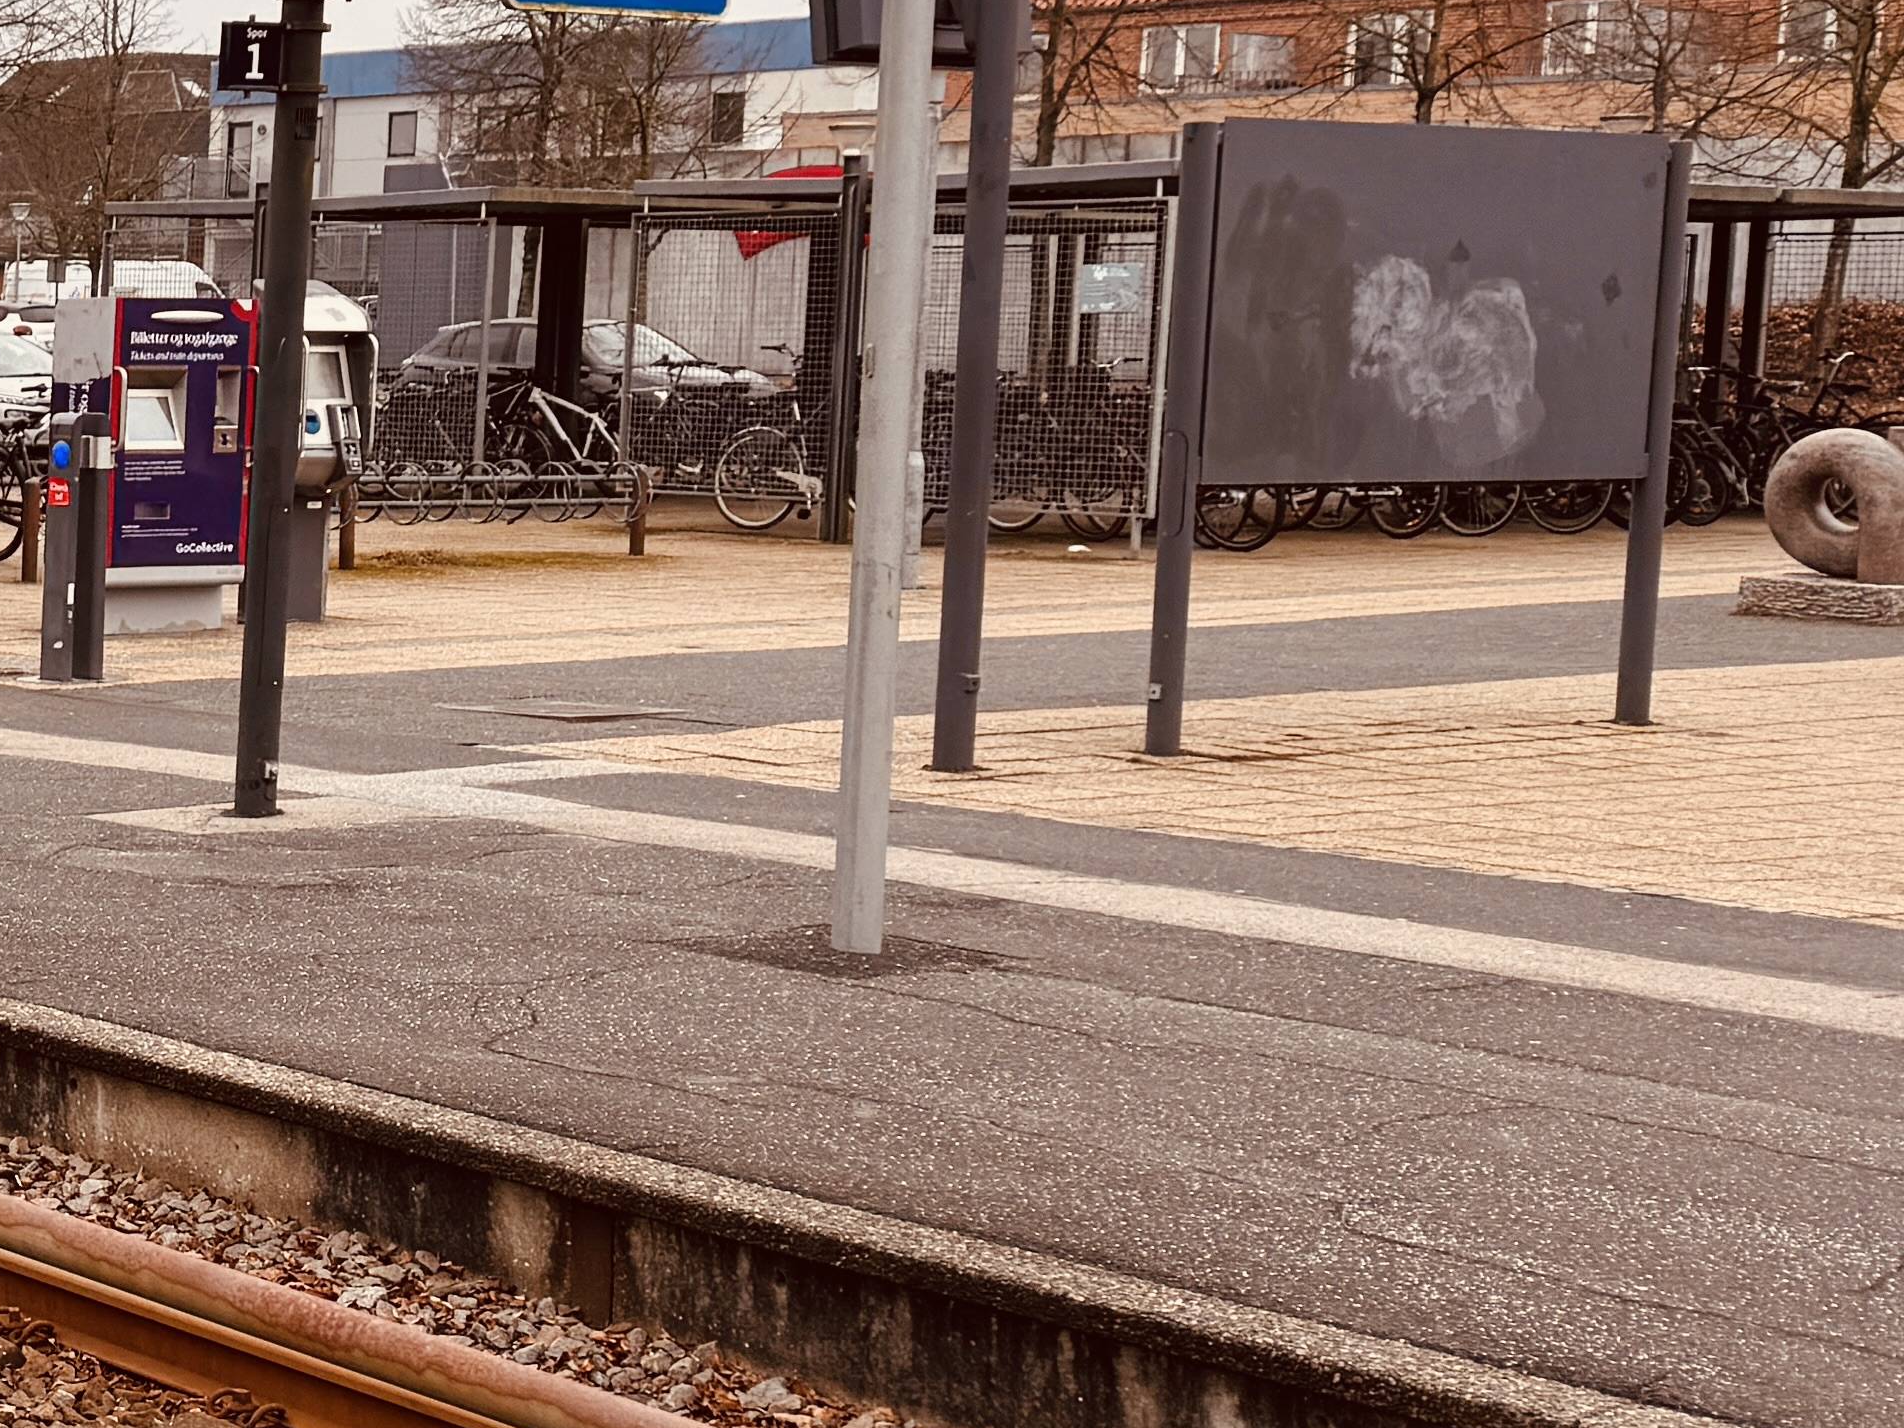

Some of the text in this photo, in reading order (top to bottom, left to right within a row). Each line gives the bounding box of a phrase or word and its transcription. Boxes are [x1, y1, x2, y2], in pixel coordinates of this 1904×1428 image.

[246, 26, 268, 40] Spor
[244, 42, 265, 80] 1
[170, 333, 184, 347] og
[175, 541, 234, 555] GoCollective
